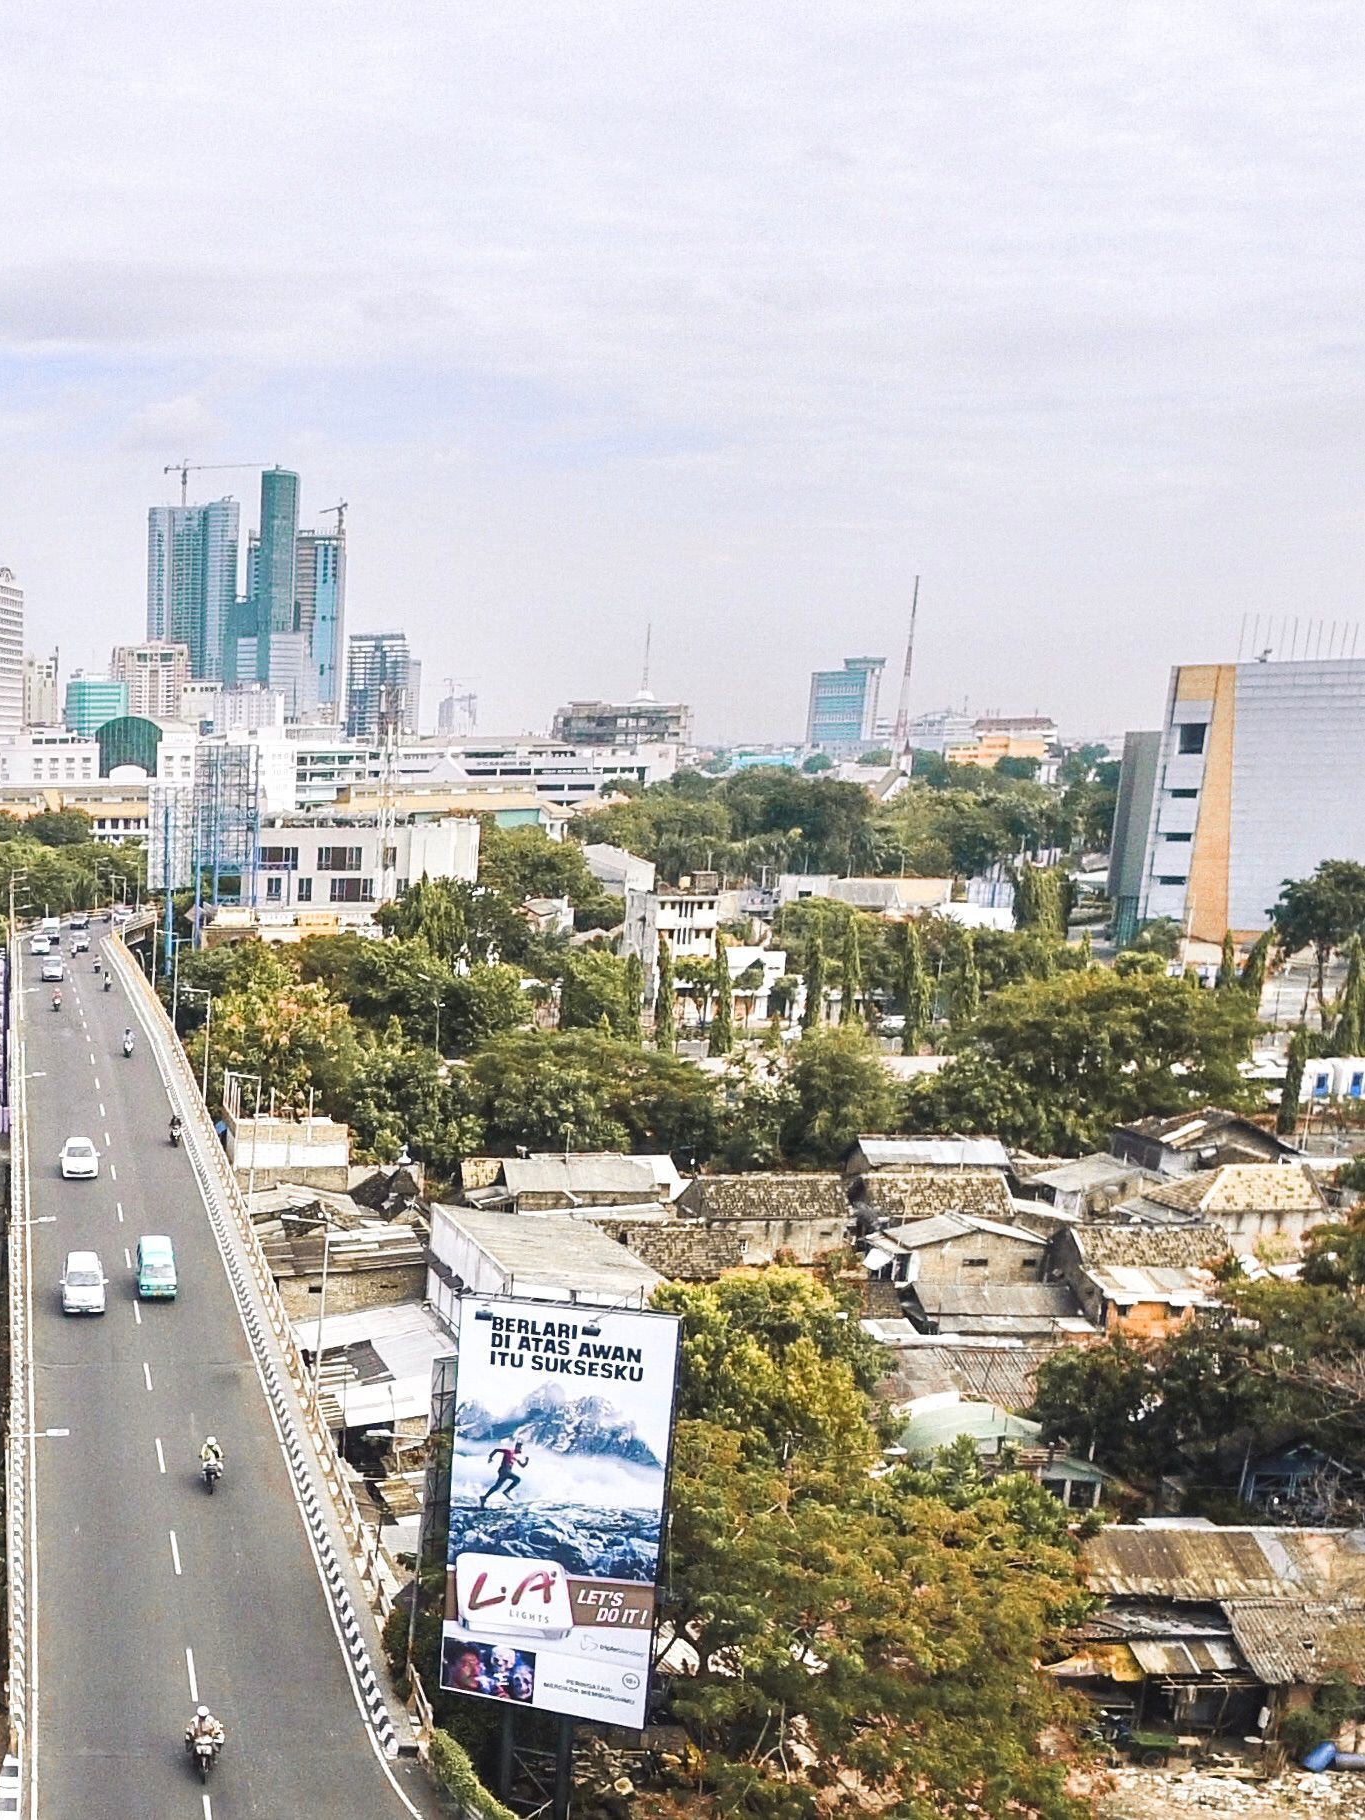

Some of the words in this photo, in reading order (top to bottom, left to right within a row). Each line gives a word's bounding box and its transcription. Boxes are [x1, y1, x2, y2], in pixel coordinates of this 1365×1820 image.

[491, 1316, 578, 1340] BERLARI
[491, 1333, 511, 1350] DI
[517, 1336, 570, 1356] ATAS
[577, 1343, 642, 1364] AWAN
[490, 1351, 524, 1368] ITU
[531, 1355, 644, 1382] SUKSESKU
[577, 1589, 625, 1607] LET'S
[509, 1610, 550, 1624] LIGHTS
[596, 1607, 620, 1623] DO
